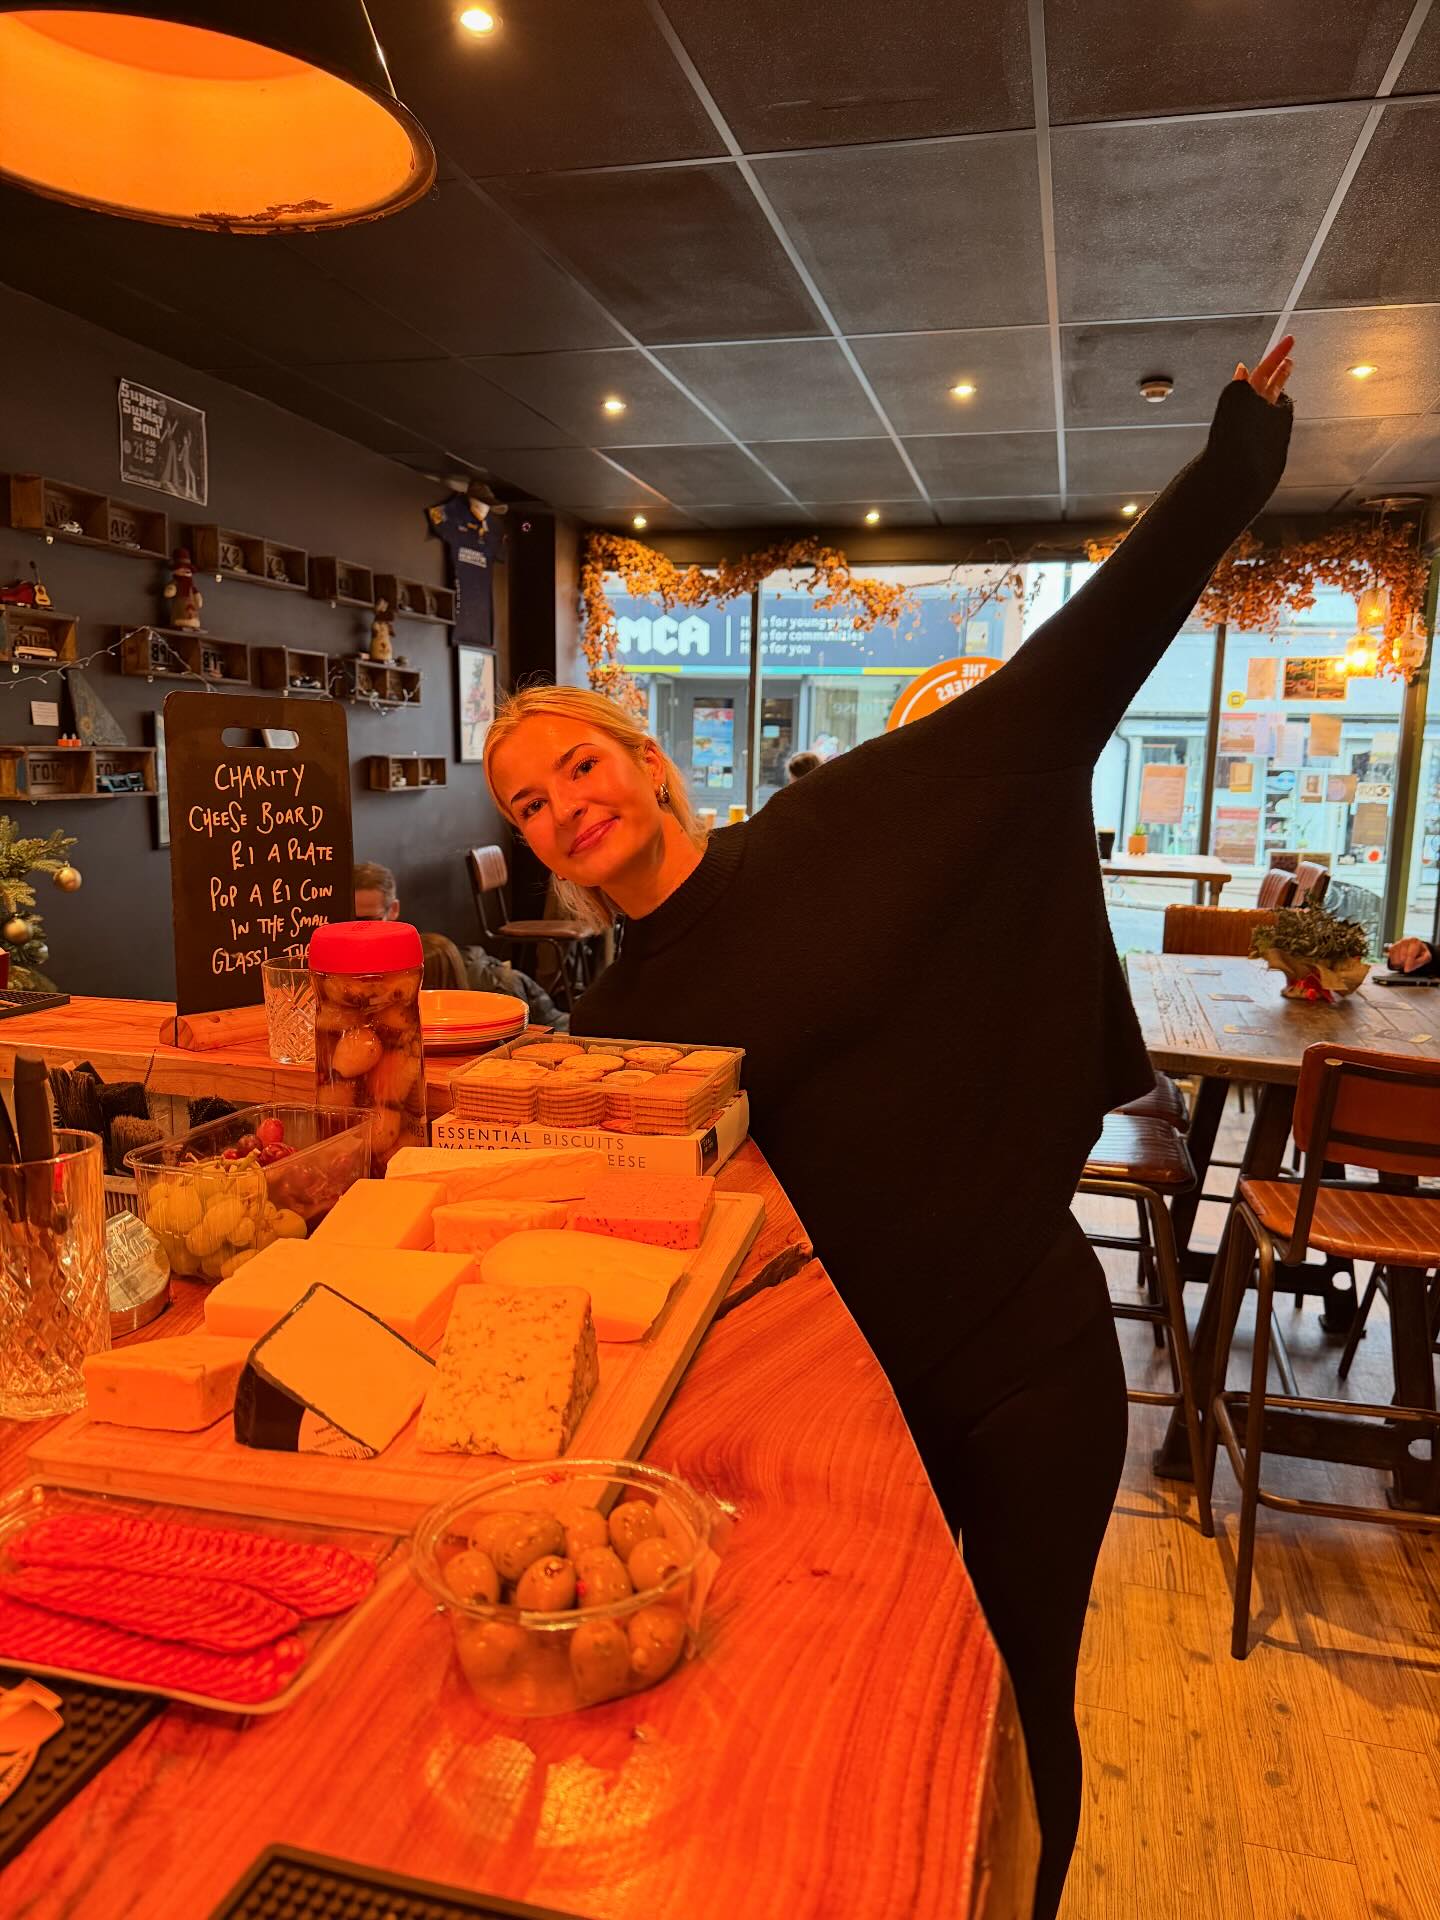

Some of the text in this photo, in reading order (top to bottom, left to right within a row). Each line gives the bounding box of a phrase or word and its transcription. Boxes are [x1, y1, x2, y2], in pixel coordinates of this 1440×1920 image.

[121, 382, 160, 409] Super
[122, 398, 164, 429] Sunday
[133, 416, 160, 440] Soul
[606, 614, 710, 656] MCA
[740, 615, 768, 628] He
[769, 615, 788, 628] for
[788, 617, 827, 631] young
[740, 628, 768, 641] He
[769, 628, 788, 641] for
[740, 641, 812, 657] He for you
[214, 763, 305, 798] CHARITY
[189, 801, 323, 837] CHEESE BOARD
[267, 843, 281, 863] A
[287, 838, 333, 866] PLATE
[210, 876, 238, 911] POP
[249, 883, 263, 906] A
[300, 879, 333, 901] COIN
[231, 906, 329, 941] IN THE SMALL
[438, 1126, 532, 1144] ESSENTIAL
[543, 1133, 624, 1150] BISCUITS
[607, 1154, 647, 1168] EESE
